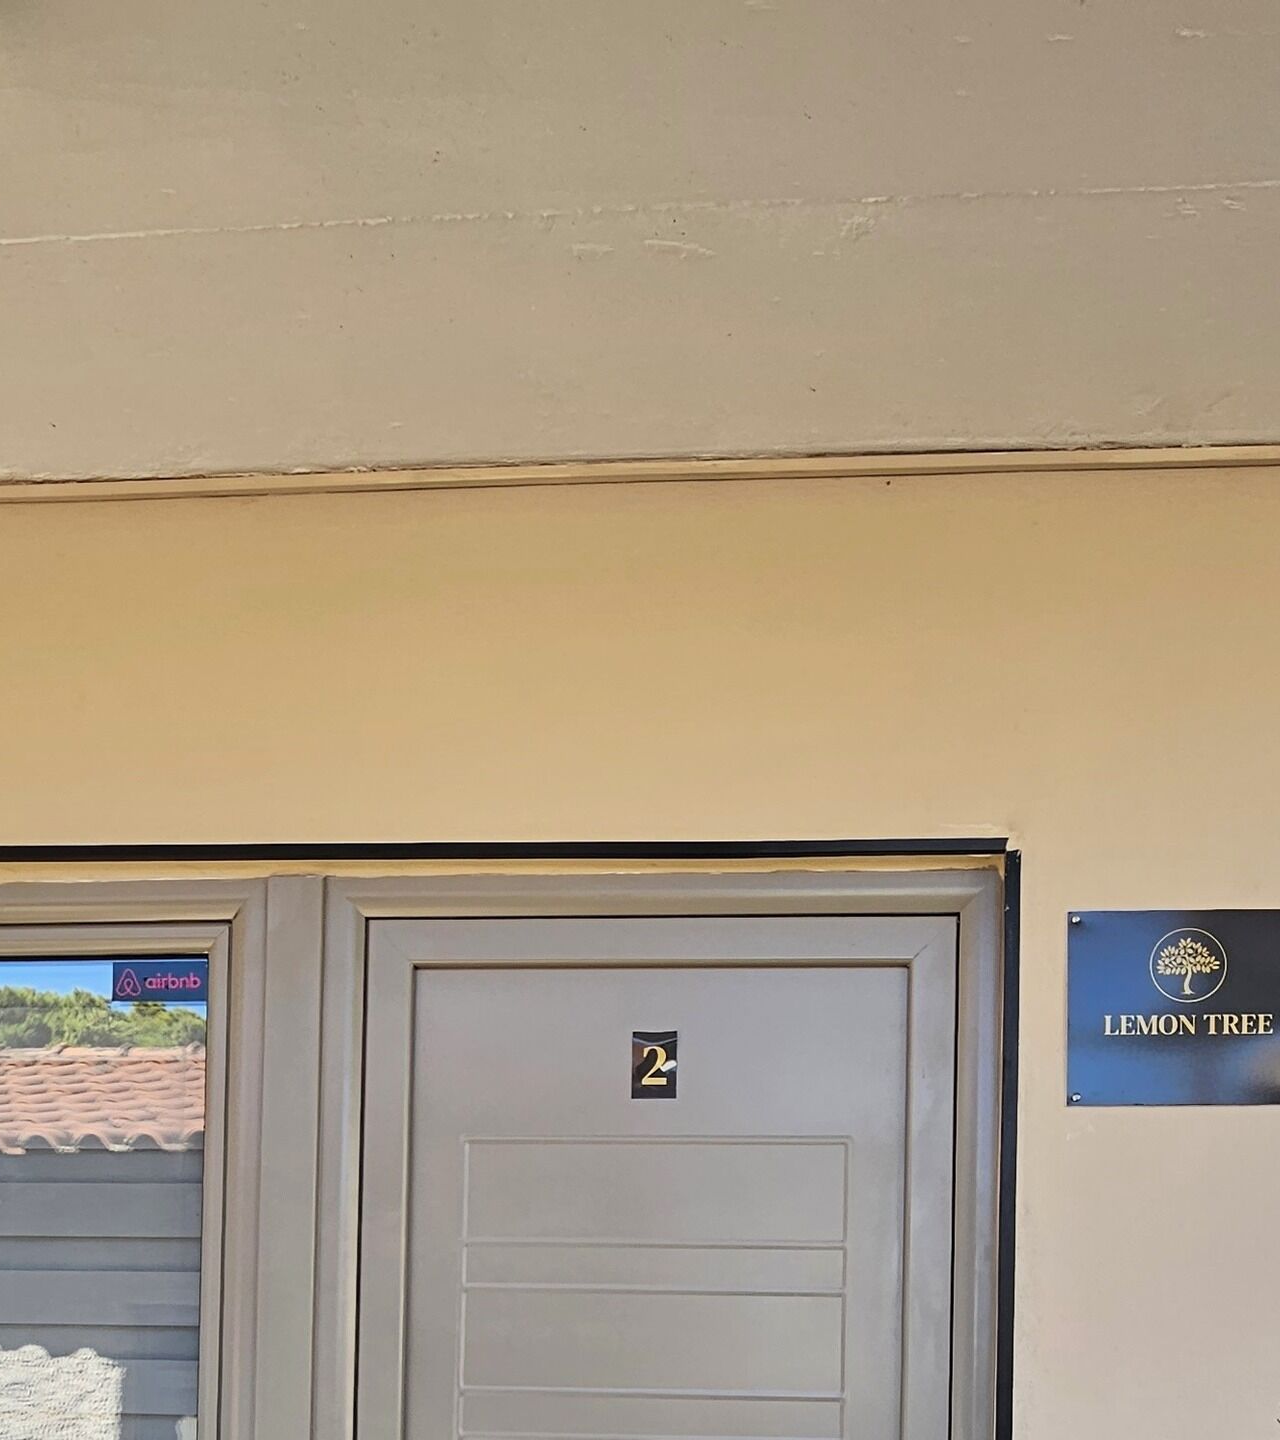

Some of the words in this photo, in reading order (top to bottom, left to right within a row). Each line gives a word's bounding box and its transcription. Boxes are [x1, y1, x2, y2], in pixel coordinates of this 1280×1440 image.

[145, 973, 201, 989] airbnb
[1104, 1014, 1196, 1035] LEMON
[1203, 1014, 1273, 1035] TREE
[642, 1046, 667, 1085] 2
